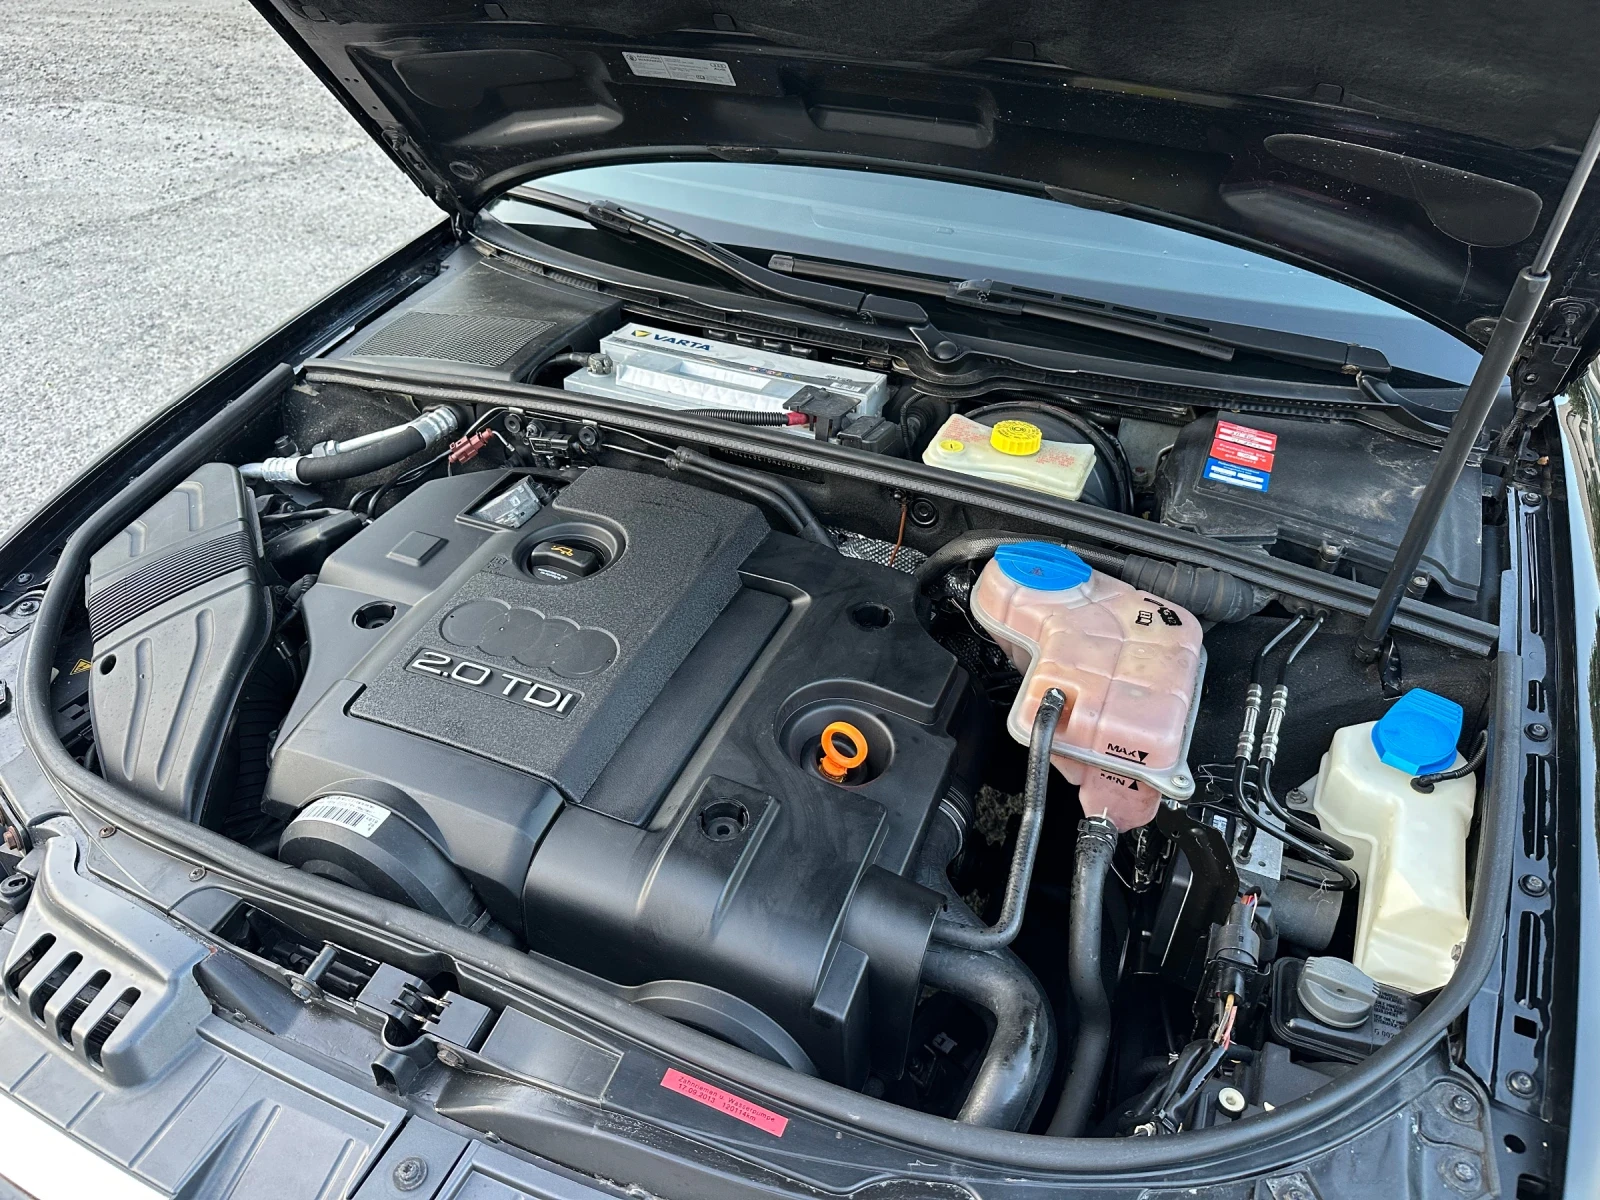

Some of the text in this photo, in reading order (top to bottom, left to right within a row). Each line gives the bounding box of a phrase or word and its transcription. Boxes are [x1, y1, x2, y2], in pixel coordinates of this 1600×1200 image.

[652, 332, 711, 351] VARTA
[411, 651, 573, 713] 2.0 TDI
[1107, 742, 1137, 757] MAX
[678, 1083, 716, 1104] 17.09.2013
[728, 1096, 775, 1123] Wasserpumpe
